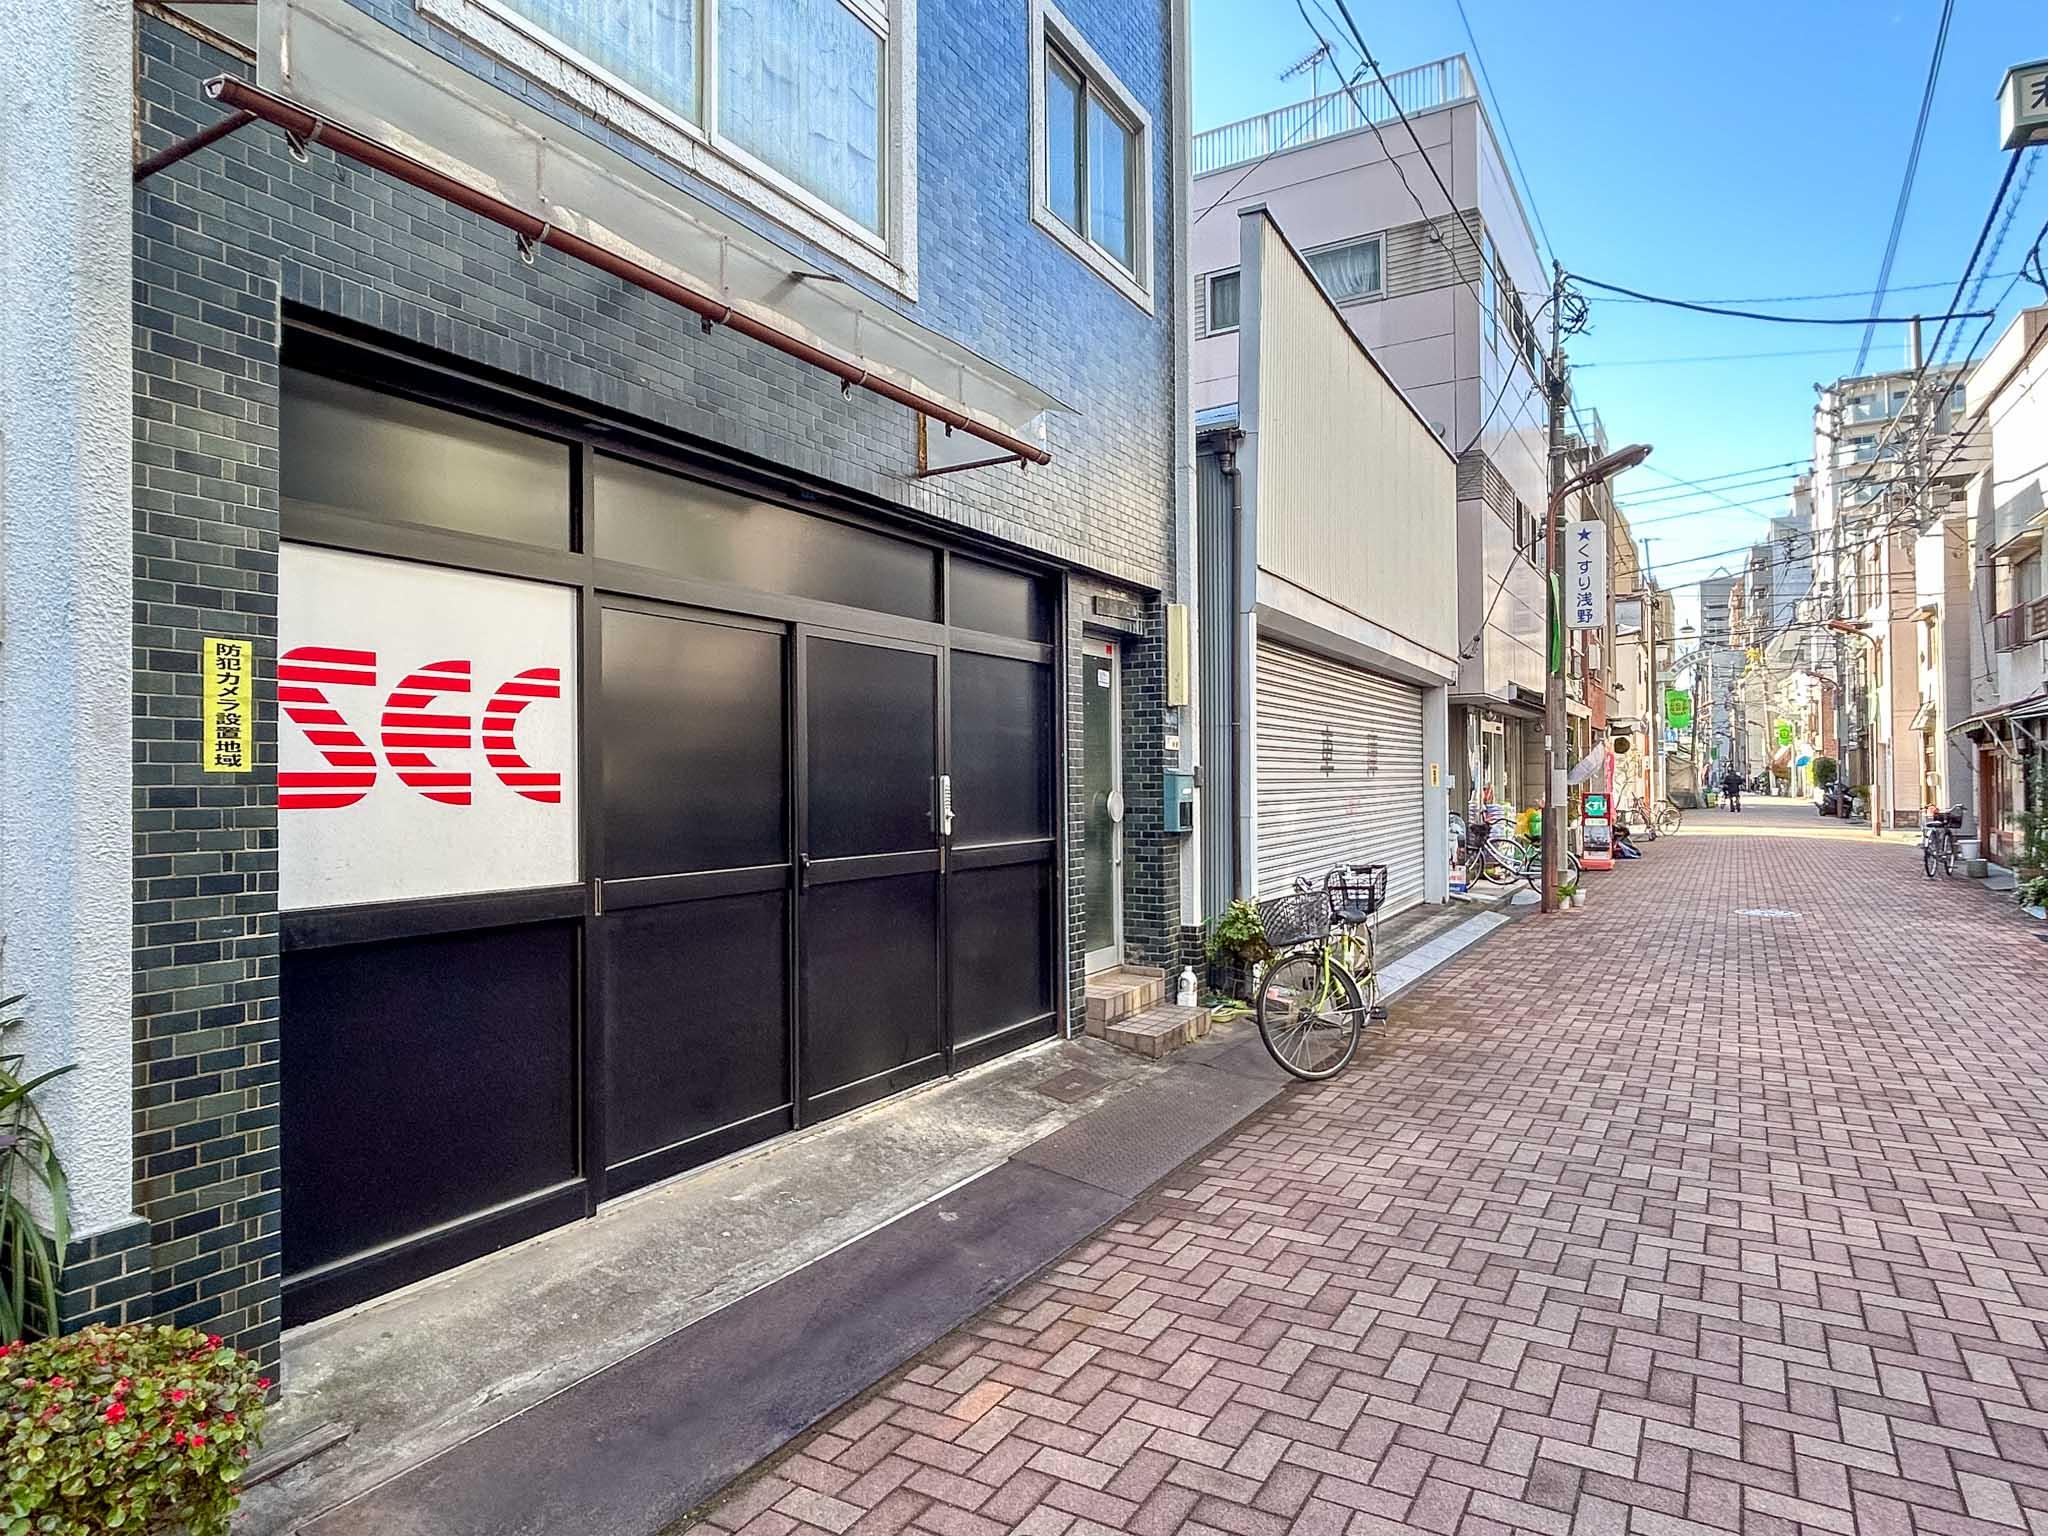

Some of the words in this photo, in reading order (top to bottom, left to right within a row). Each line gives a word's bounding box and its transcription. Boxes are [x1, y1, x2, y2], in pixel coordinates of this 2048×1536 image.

[1576, 543, 1593, 624] くすり浅野
[214, 643, 242, 767] 防犯カメラ設置地域
